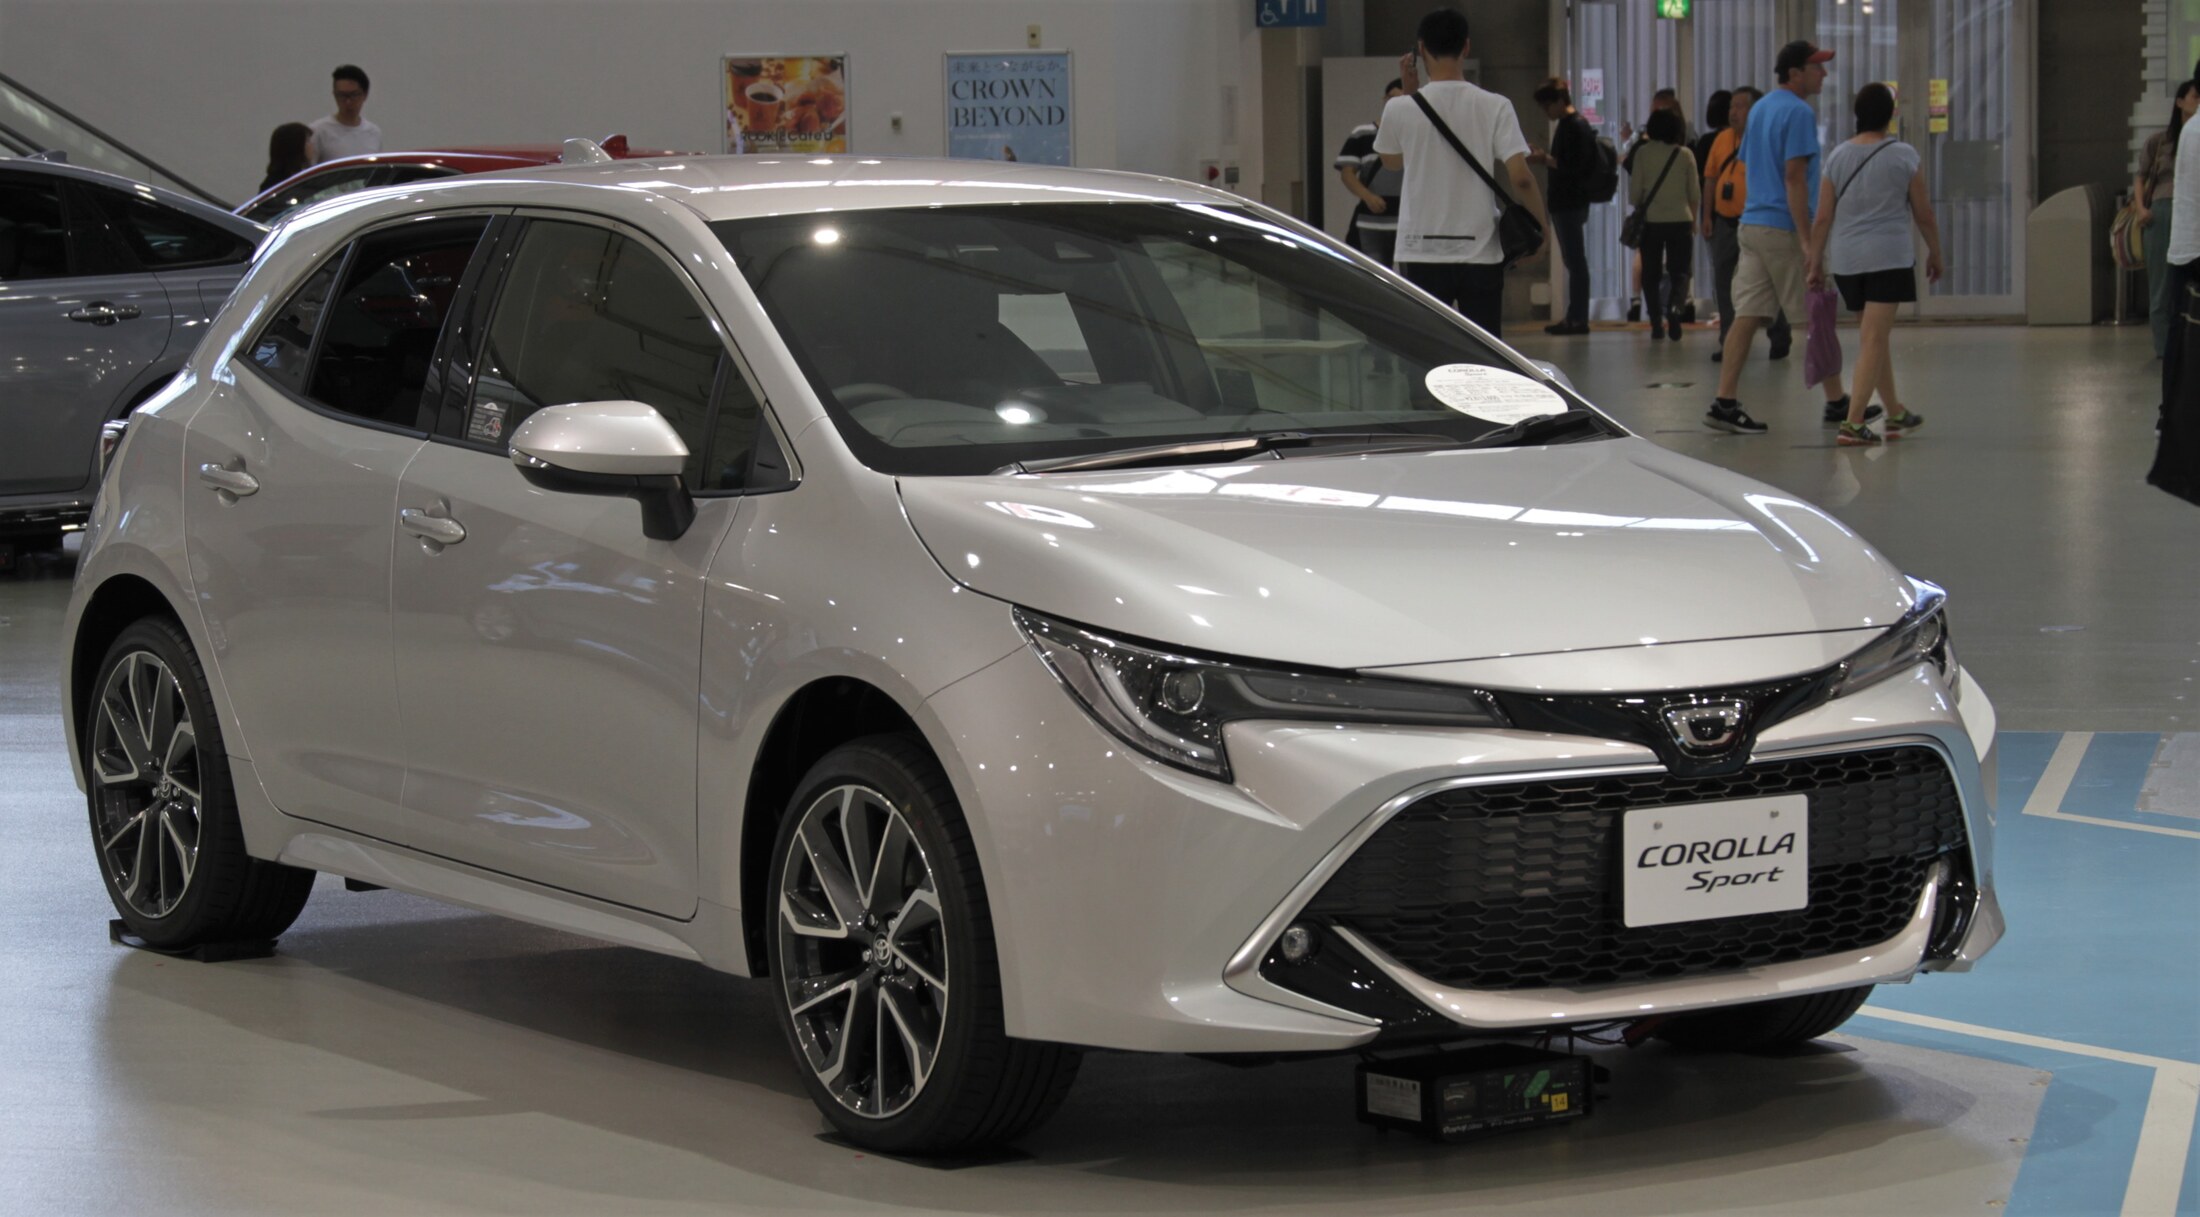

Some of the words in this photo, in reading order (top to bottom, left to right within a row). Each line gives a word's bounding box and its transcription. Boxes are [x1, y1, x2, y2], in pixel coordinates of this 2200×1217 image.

[951, 78, 1057, 101] CROWN
[953, 105, 1066, 128] BEYOND
[1637, 832, 1796, 868] COROLLA
[1685, 866, 1784, 893] Sport
